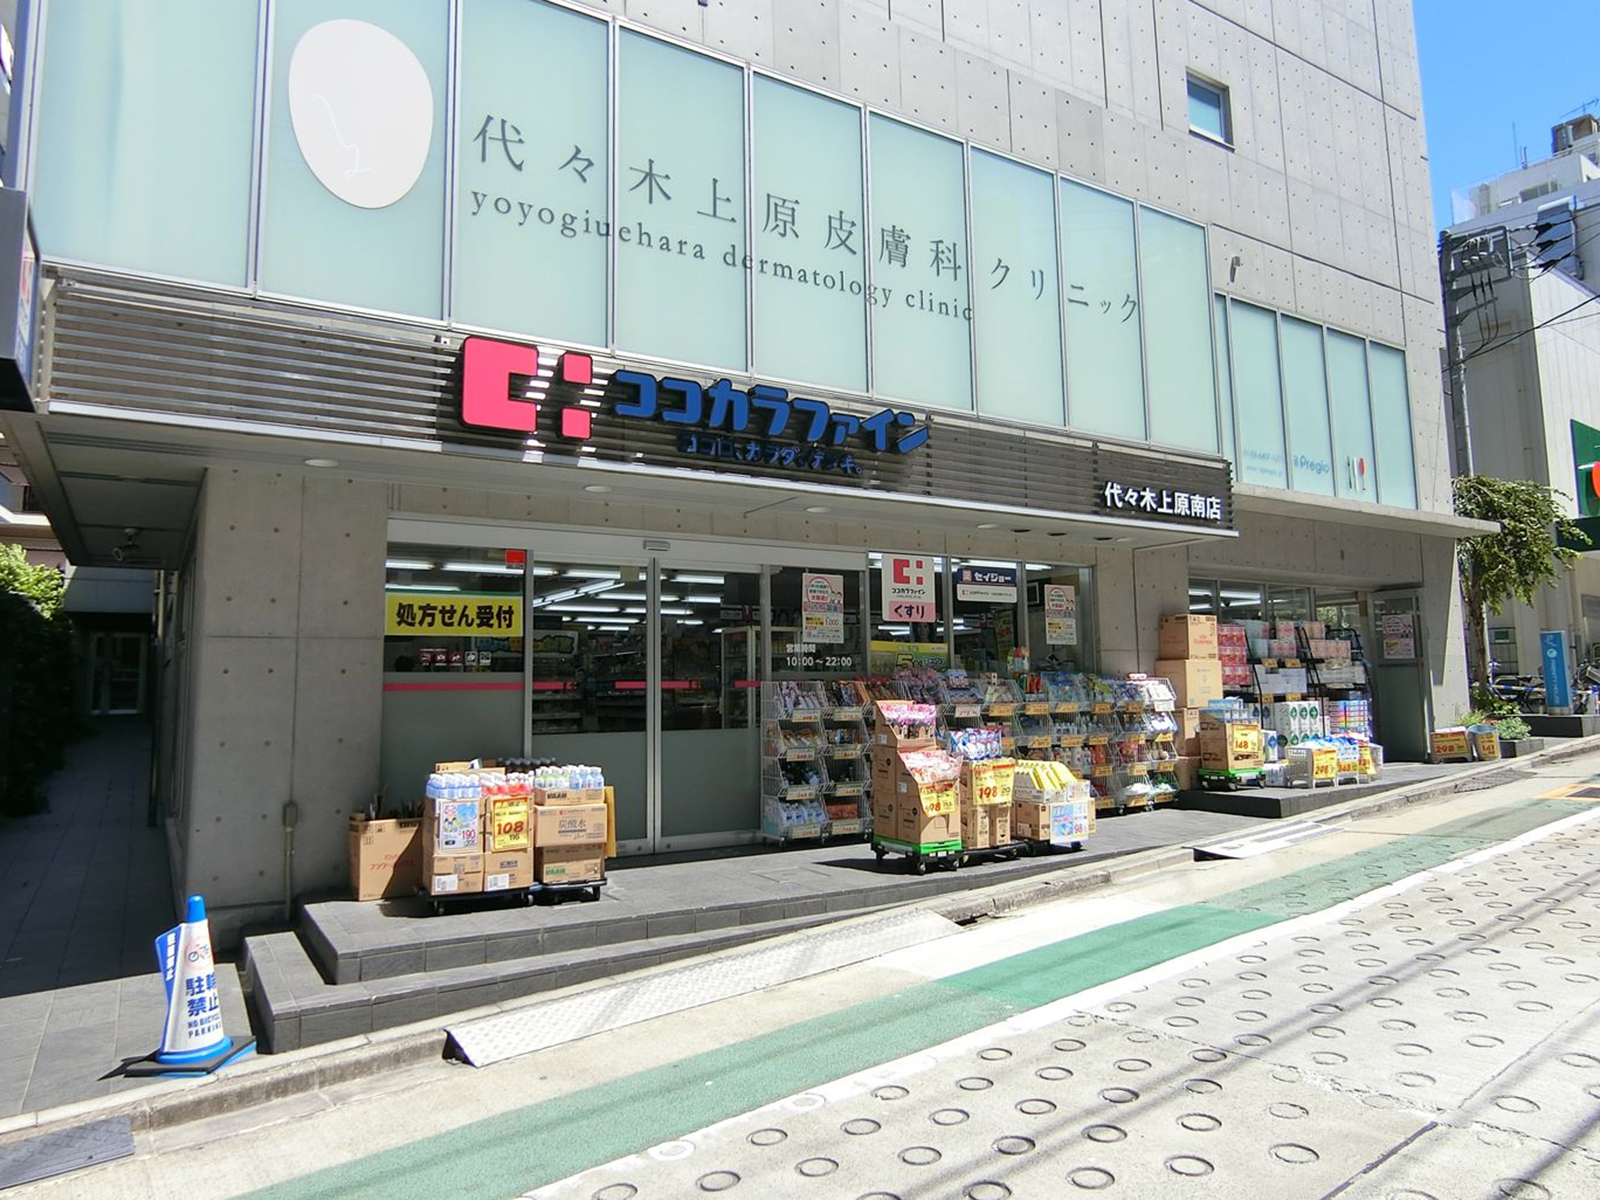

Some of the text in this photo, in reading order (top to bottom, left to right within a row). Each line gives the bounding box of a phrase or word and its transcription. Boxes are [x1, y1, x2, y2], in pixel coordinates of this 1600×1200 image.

[472, 113, 1139, 323] 代々木上原皮膚科クリニック
[471, 189, 973, 321] yoyogiuehara dermatology clinic
[614, 370, 929, 455] ココカラファイン
[1104, 481, 1221, 519] 代々木上原南店
[974, 571, 1012, 582] セイジョー
[396, 602, 514, 629] 処方せん受付
[893, 604, 926, 619] くすり
[1435, 744, 1455, 754] 298
[978, 785, 998, 799] 198
[462, 829, 476, 840] 190
[497, 820, 524, 835] 108
[187, 992, 219, 1017] 禁止
